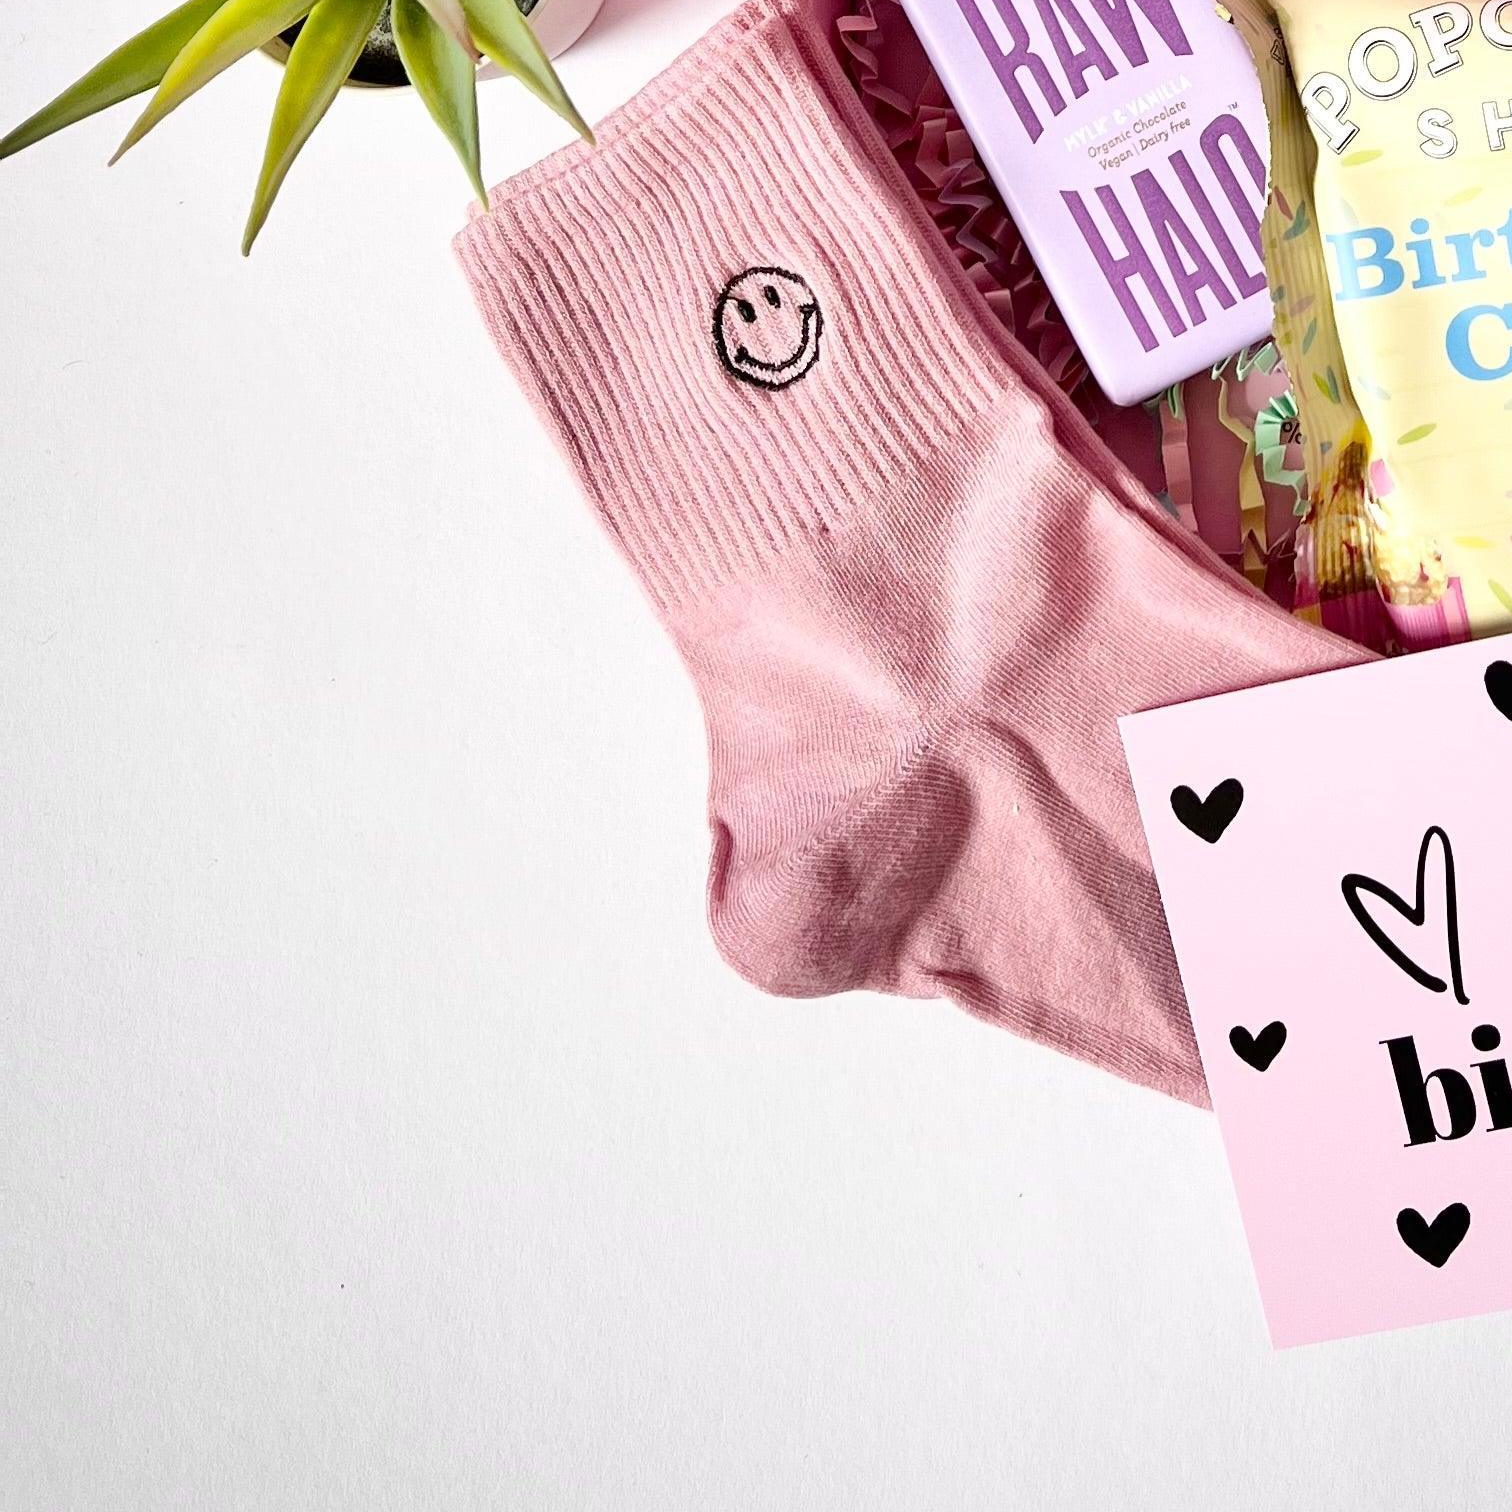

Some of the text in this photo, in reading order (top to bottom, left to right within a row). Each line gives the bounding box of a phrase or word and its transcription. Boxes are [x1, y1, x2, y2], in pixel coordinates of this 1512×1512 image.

[1130, 73, 1193, 120] VANILLA
[1087, 100, 1187, 159] Organic Chocolate
[1099, 149, 1134, 171] Vegan
[1139, 129, 1169, 152] Dairy
[1169, 117, 1191, 135] free
